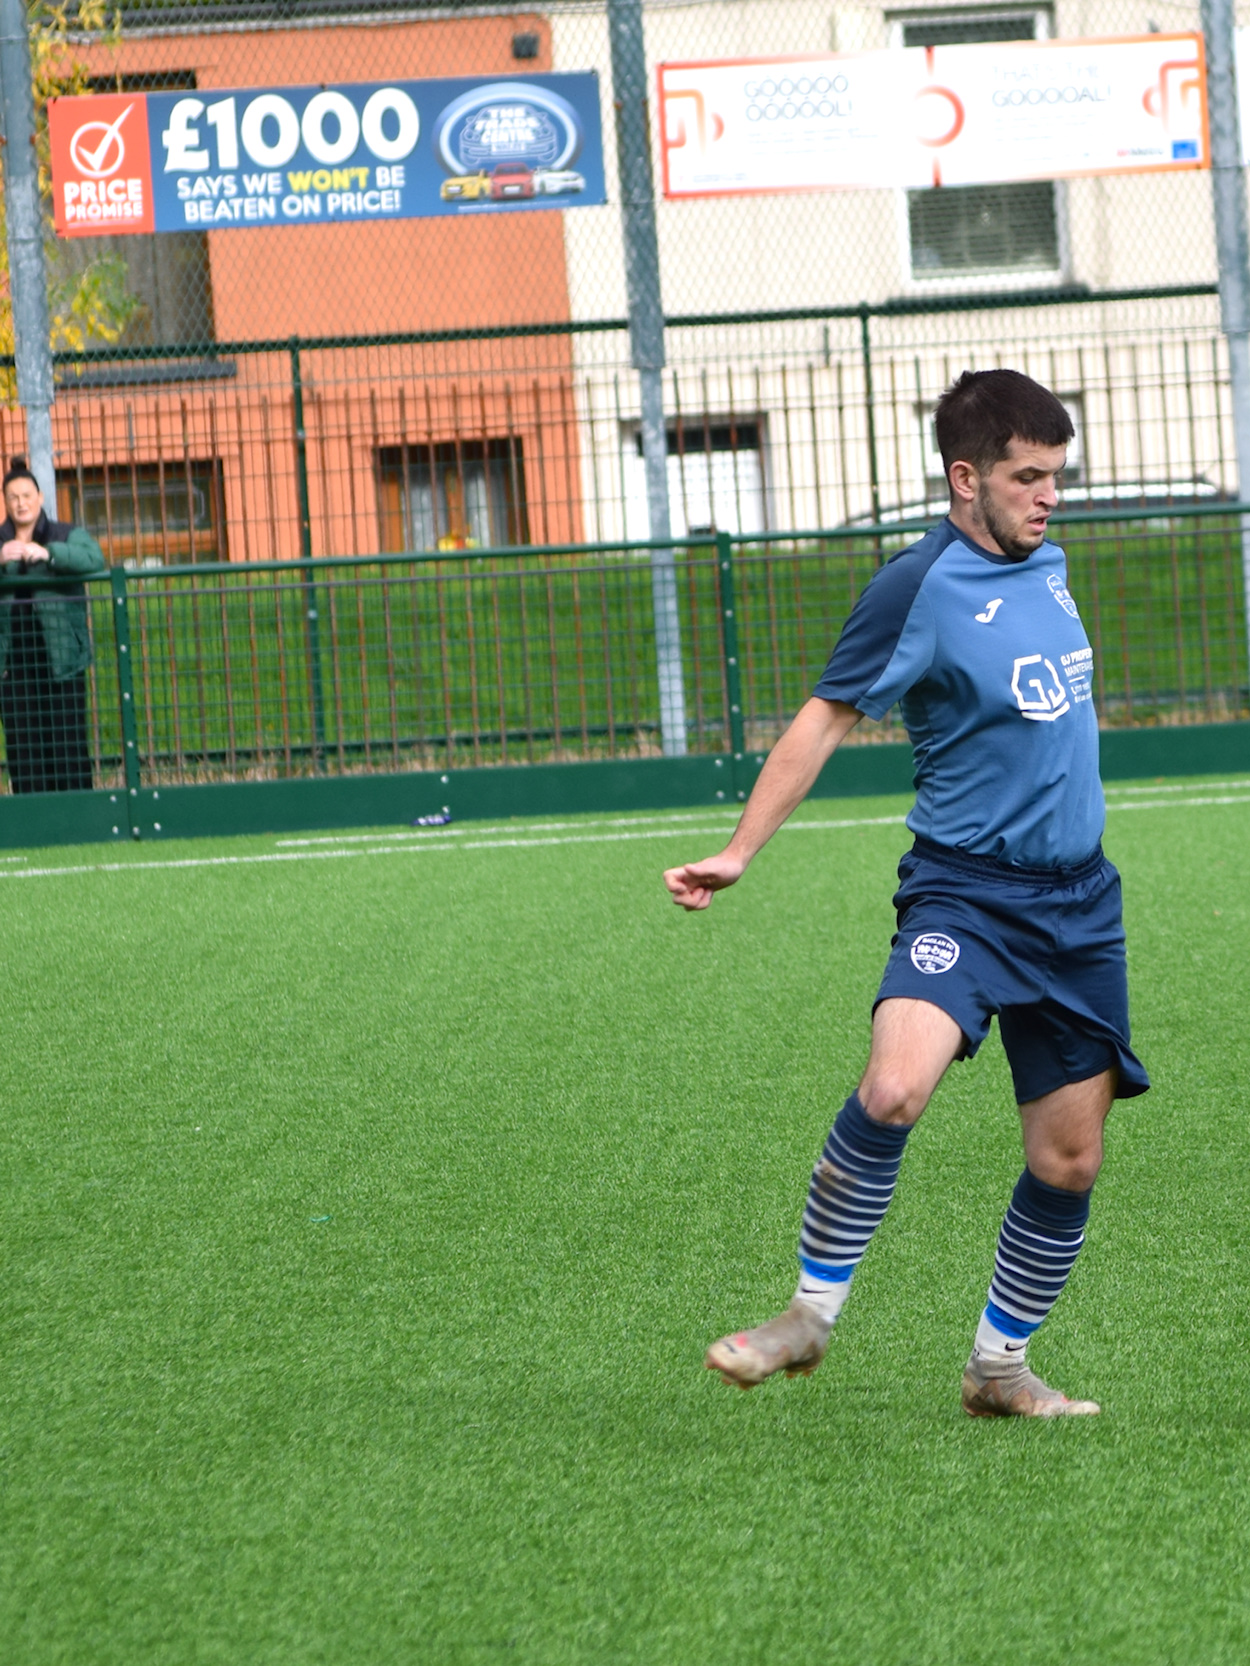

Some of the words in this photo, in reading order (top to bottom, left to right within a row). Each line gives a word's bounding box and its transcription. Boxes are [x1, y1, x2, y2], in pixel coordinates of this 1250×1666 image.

[162, 87, 420, 174] £1000
[64, 178, 143, 204] PRICE
[176, 174, 238, 200] SAYS
[242, 172, 283, 196] WE
[287, 166, 370, 192] WON'T
[375, 165, 406, 188] BE
[65, 201, 144, 222] PROMISE
[184, 196, 277, 223] BEATEN
[281, 194, 321, 217] ON
[327, 189, 401, 214] PRICE!
